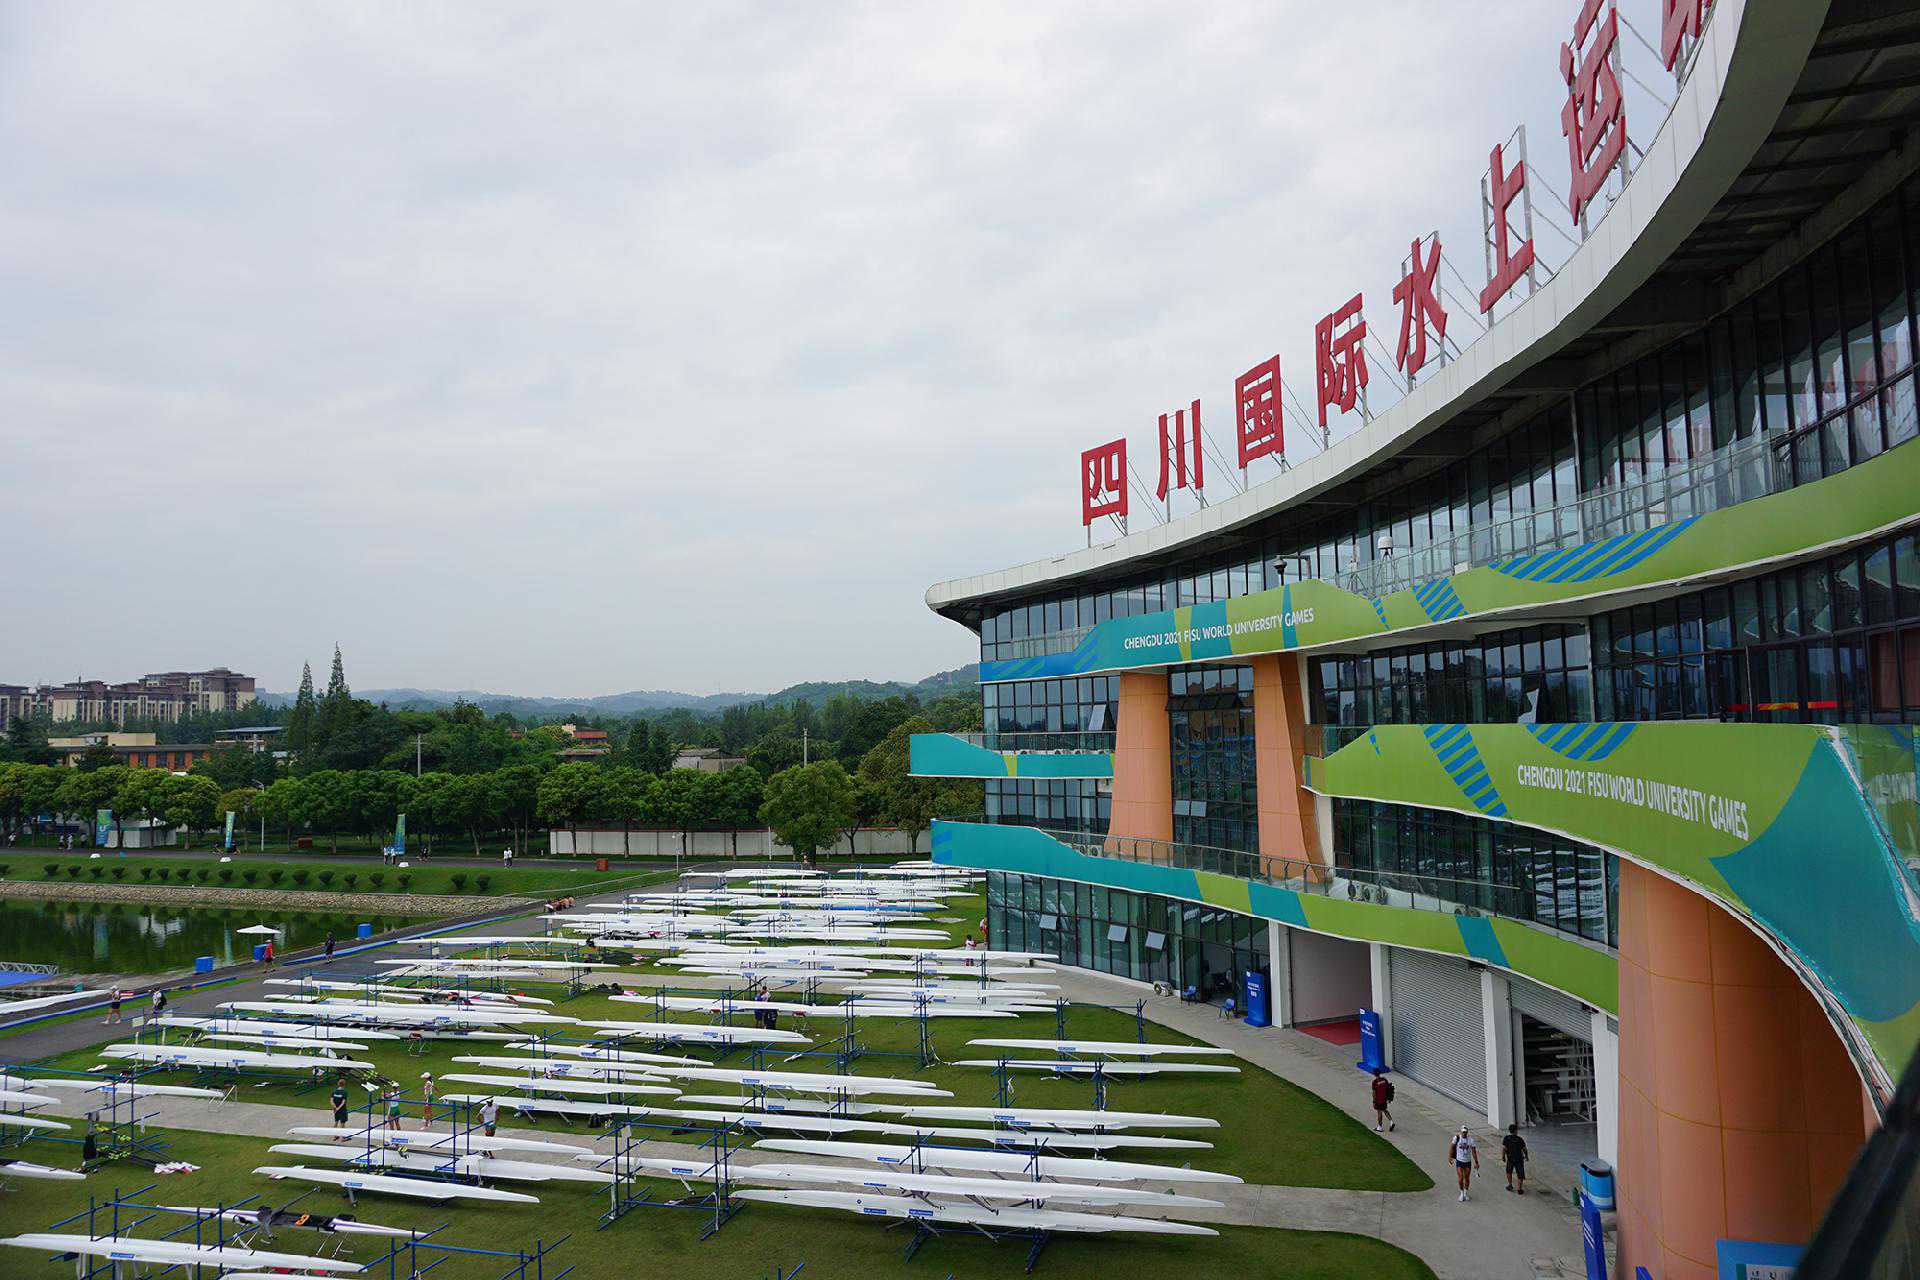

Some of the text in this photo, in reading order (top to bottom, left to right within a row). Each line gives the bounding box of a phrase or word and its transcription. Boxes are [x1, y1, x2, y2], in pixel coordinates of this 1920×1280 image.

[1124, 607, 1315, 650] CHENGDU 2021 FISU WORLD UNIVERSITY GAMES
[1517, 764, 1750, 842] CHENGDU 2021 FISU WORLD UNIVERSITY GAMES
